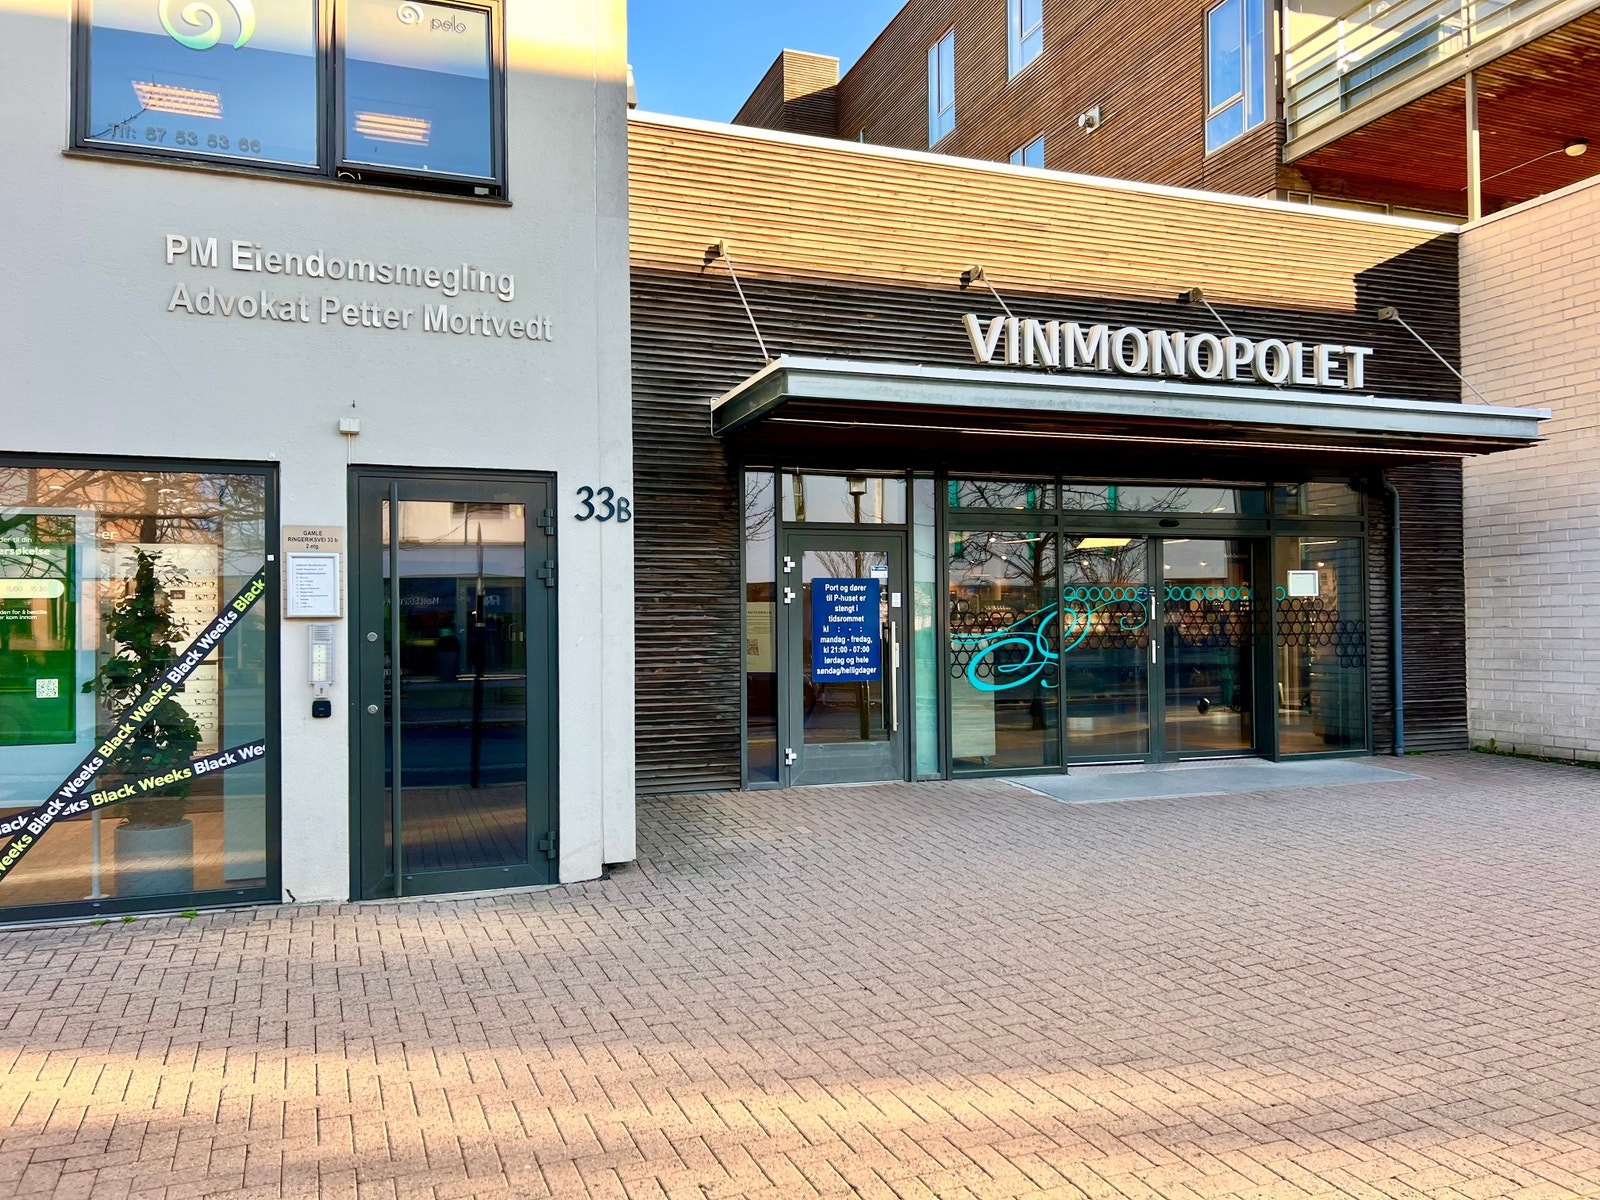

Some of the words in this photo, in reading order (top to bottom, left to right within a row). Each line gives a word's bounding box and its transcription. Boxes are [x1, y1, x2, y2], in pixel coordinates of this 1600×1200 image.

[165, 233, 219, 269] PM
[231, 239, 516, 302] Eiendomsmegling
[167, 282, 310, 323] Advokat
[319, 296, 414, 330] Petter
[423, 303, 554, 342] Mortvedt
[962, 312, 1374, 389] VINMONOPOLET
[824, 583, 839, 592] Port
[839, 584, 849, 593] og
[849, 583, 867, 592] dører
[833, 594, 858, 602] P-huset
[834, 605, 855, 613] stengt
[828, 615, 865, 623] tidsrommet
[822, 625, 830, 633] kl
[819, 636, 846, 644] mandag
[823, 646, 830, 654] kl
[830, 646, 848, 654] 21:00
[824, 656, 845, 665] lørdag
[816, 667, 877, 676] søndag/helligdager
[27, 798, 66, 835] Black
[58, 756, 104, 799] Weeks
[98, 721, 136, 758] Black
[129, 682, 173, 724] Weeks
[166, 649, 204, 684] Black
[196, 610, 239, 650] Weeks
[232, 578, 266, 613] Black
[0, 814, 29, 835] ack
[90, 783, 137, 807] Black
[137, 766, 193, 791] Weeks
[192, 752, 237, 775] Black
